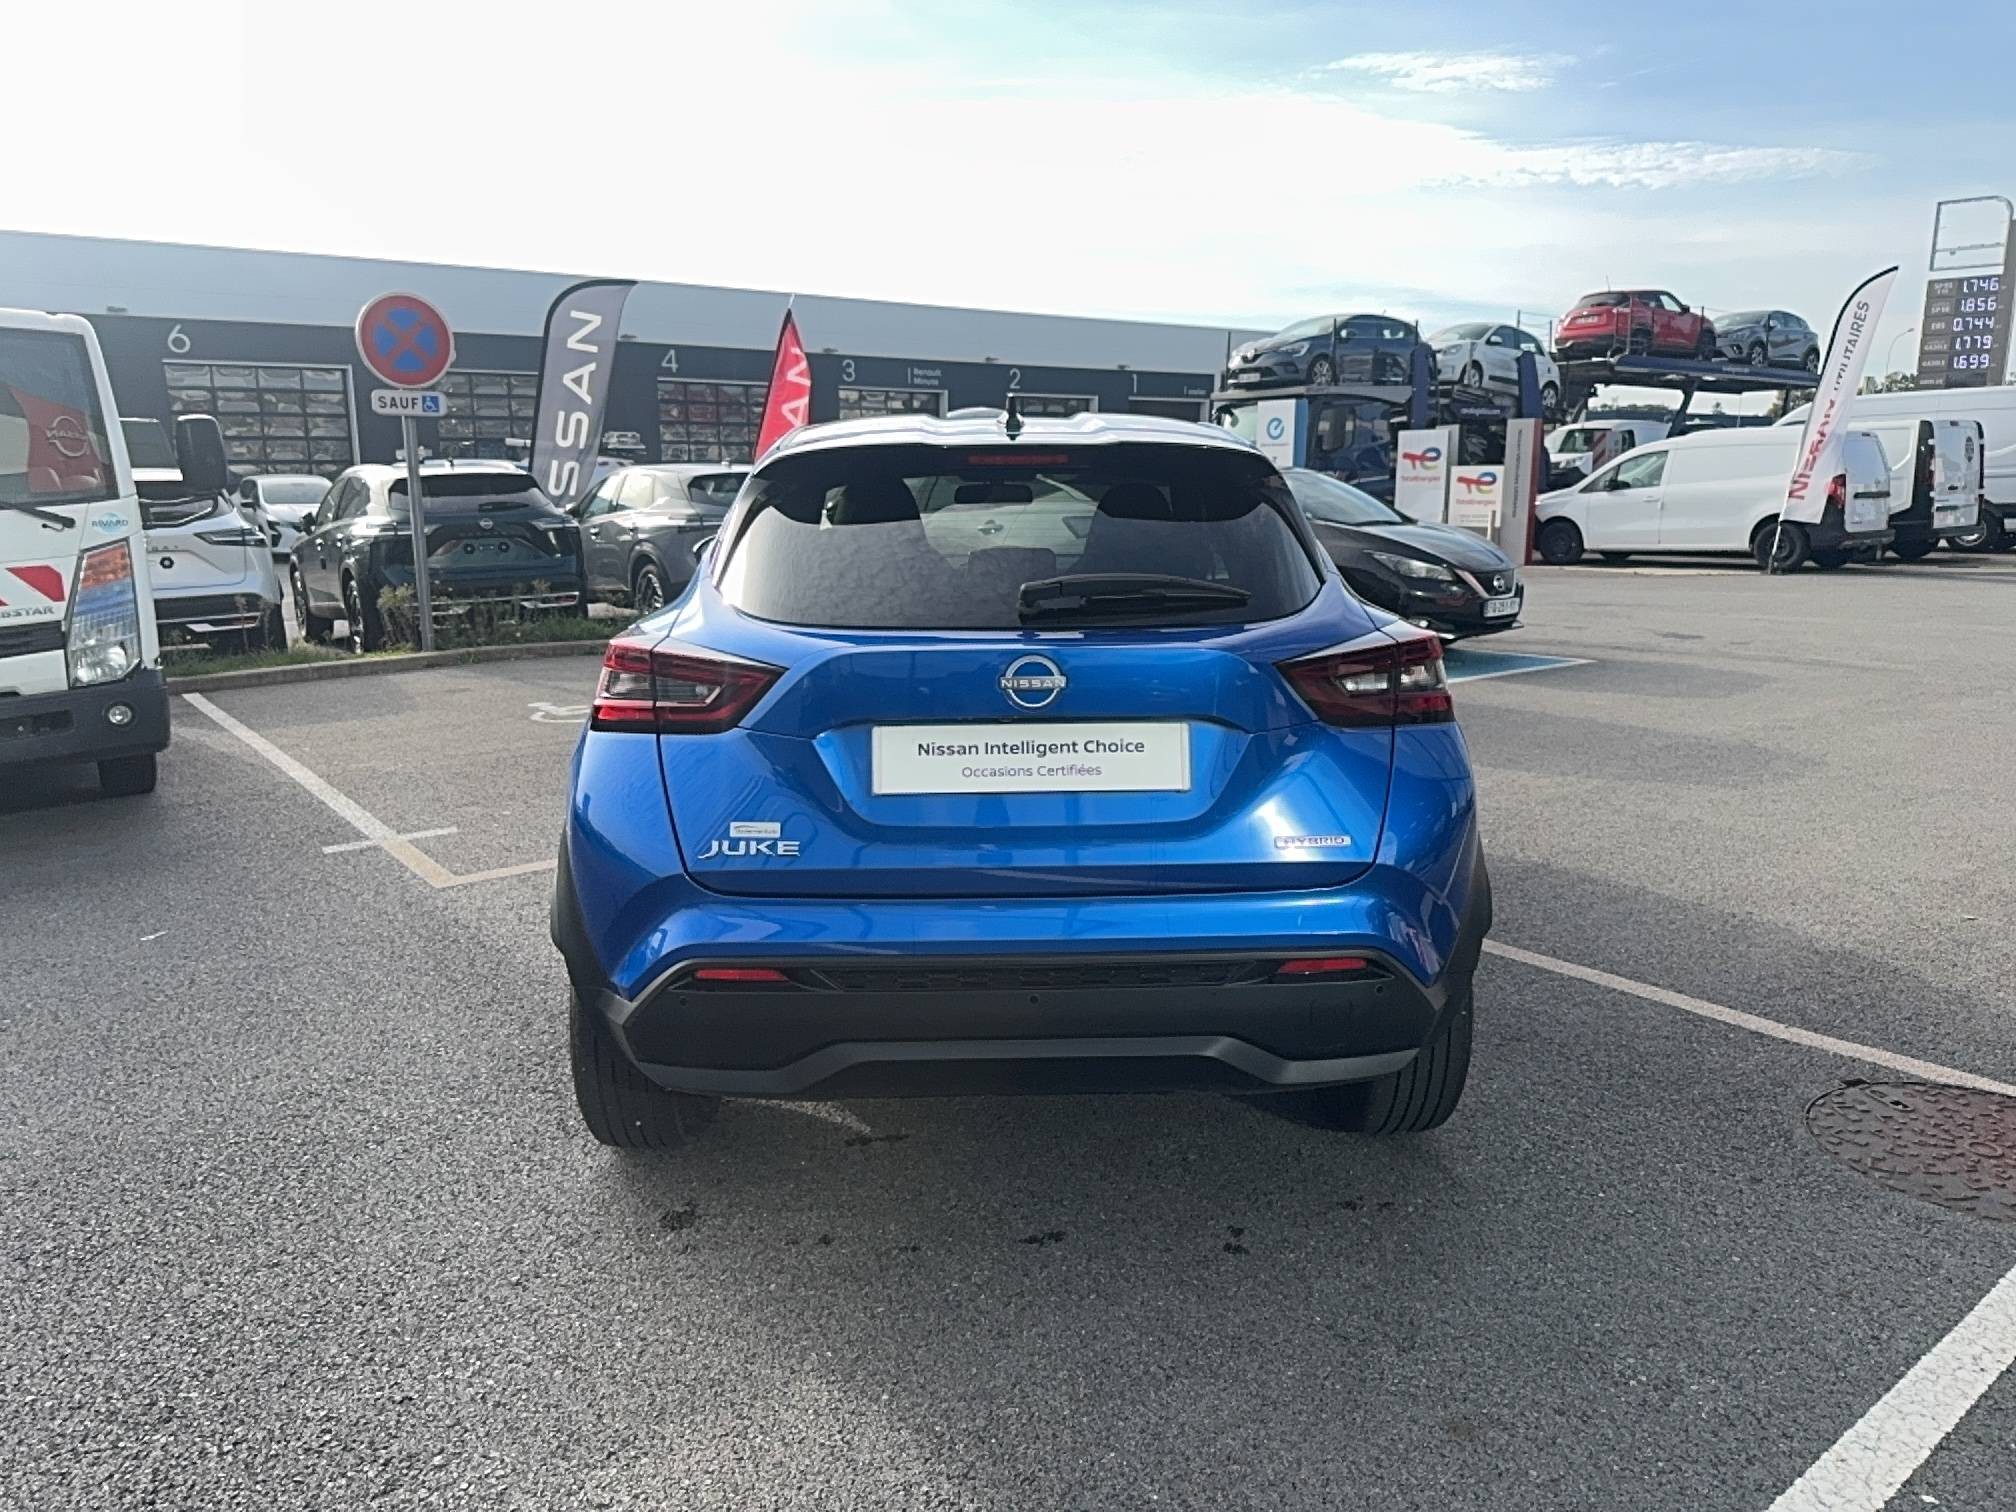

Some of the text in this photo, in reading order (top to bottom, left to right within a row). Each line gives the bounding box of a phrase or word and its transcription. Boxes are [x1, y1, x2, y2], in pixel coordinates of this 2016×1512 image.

[167, 324, 191, 354] 6
[660, 349, 679, 373] 4
[842, 359, 856, 382] 3
[1009, 367, 1021, 389] 2
[1132, 373, 1137, 393] 1
[377, 395, 419, 409] SAUF
[1001, 678, 1067, 690] NISSAN
[917, 738, 1145, 758] Nissan Intelligent Choice
[961, 763, 1102, 778] Occasions Certifiées
[698, 840, 801, 859] JUKE
